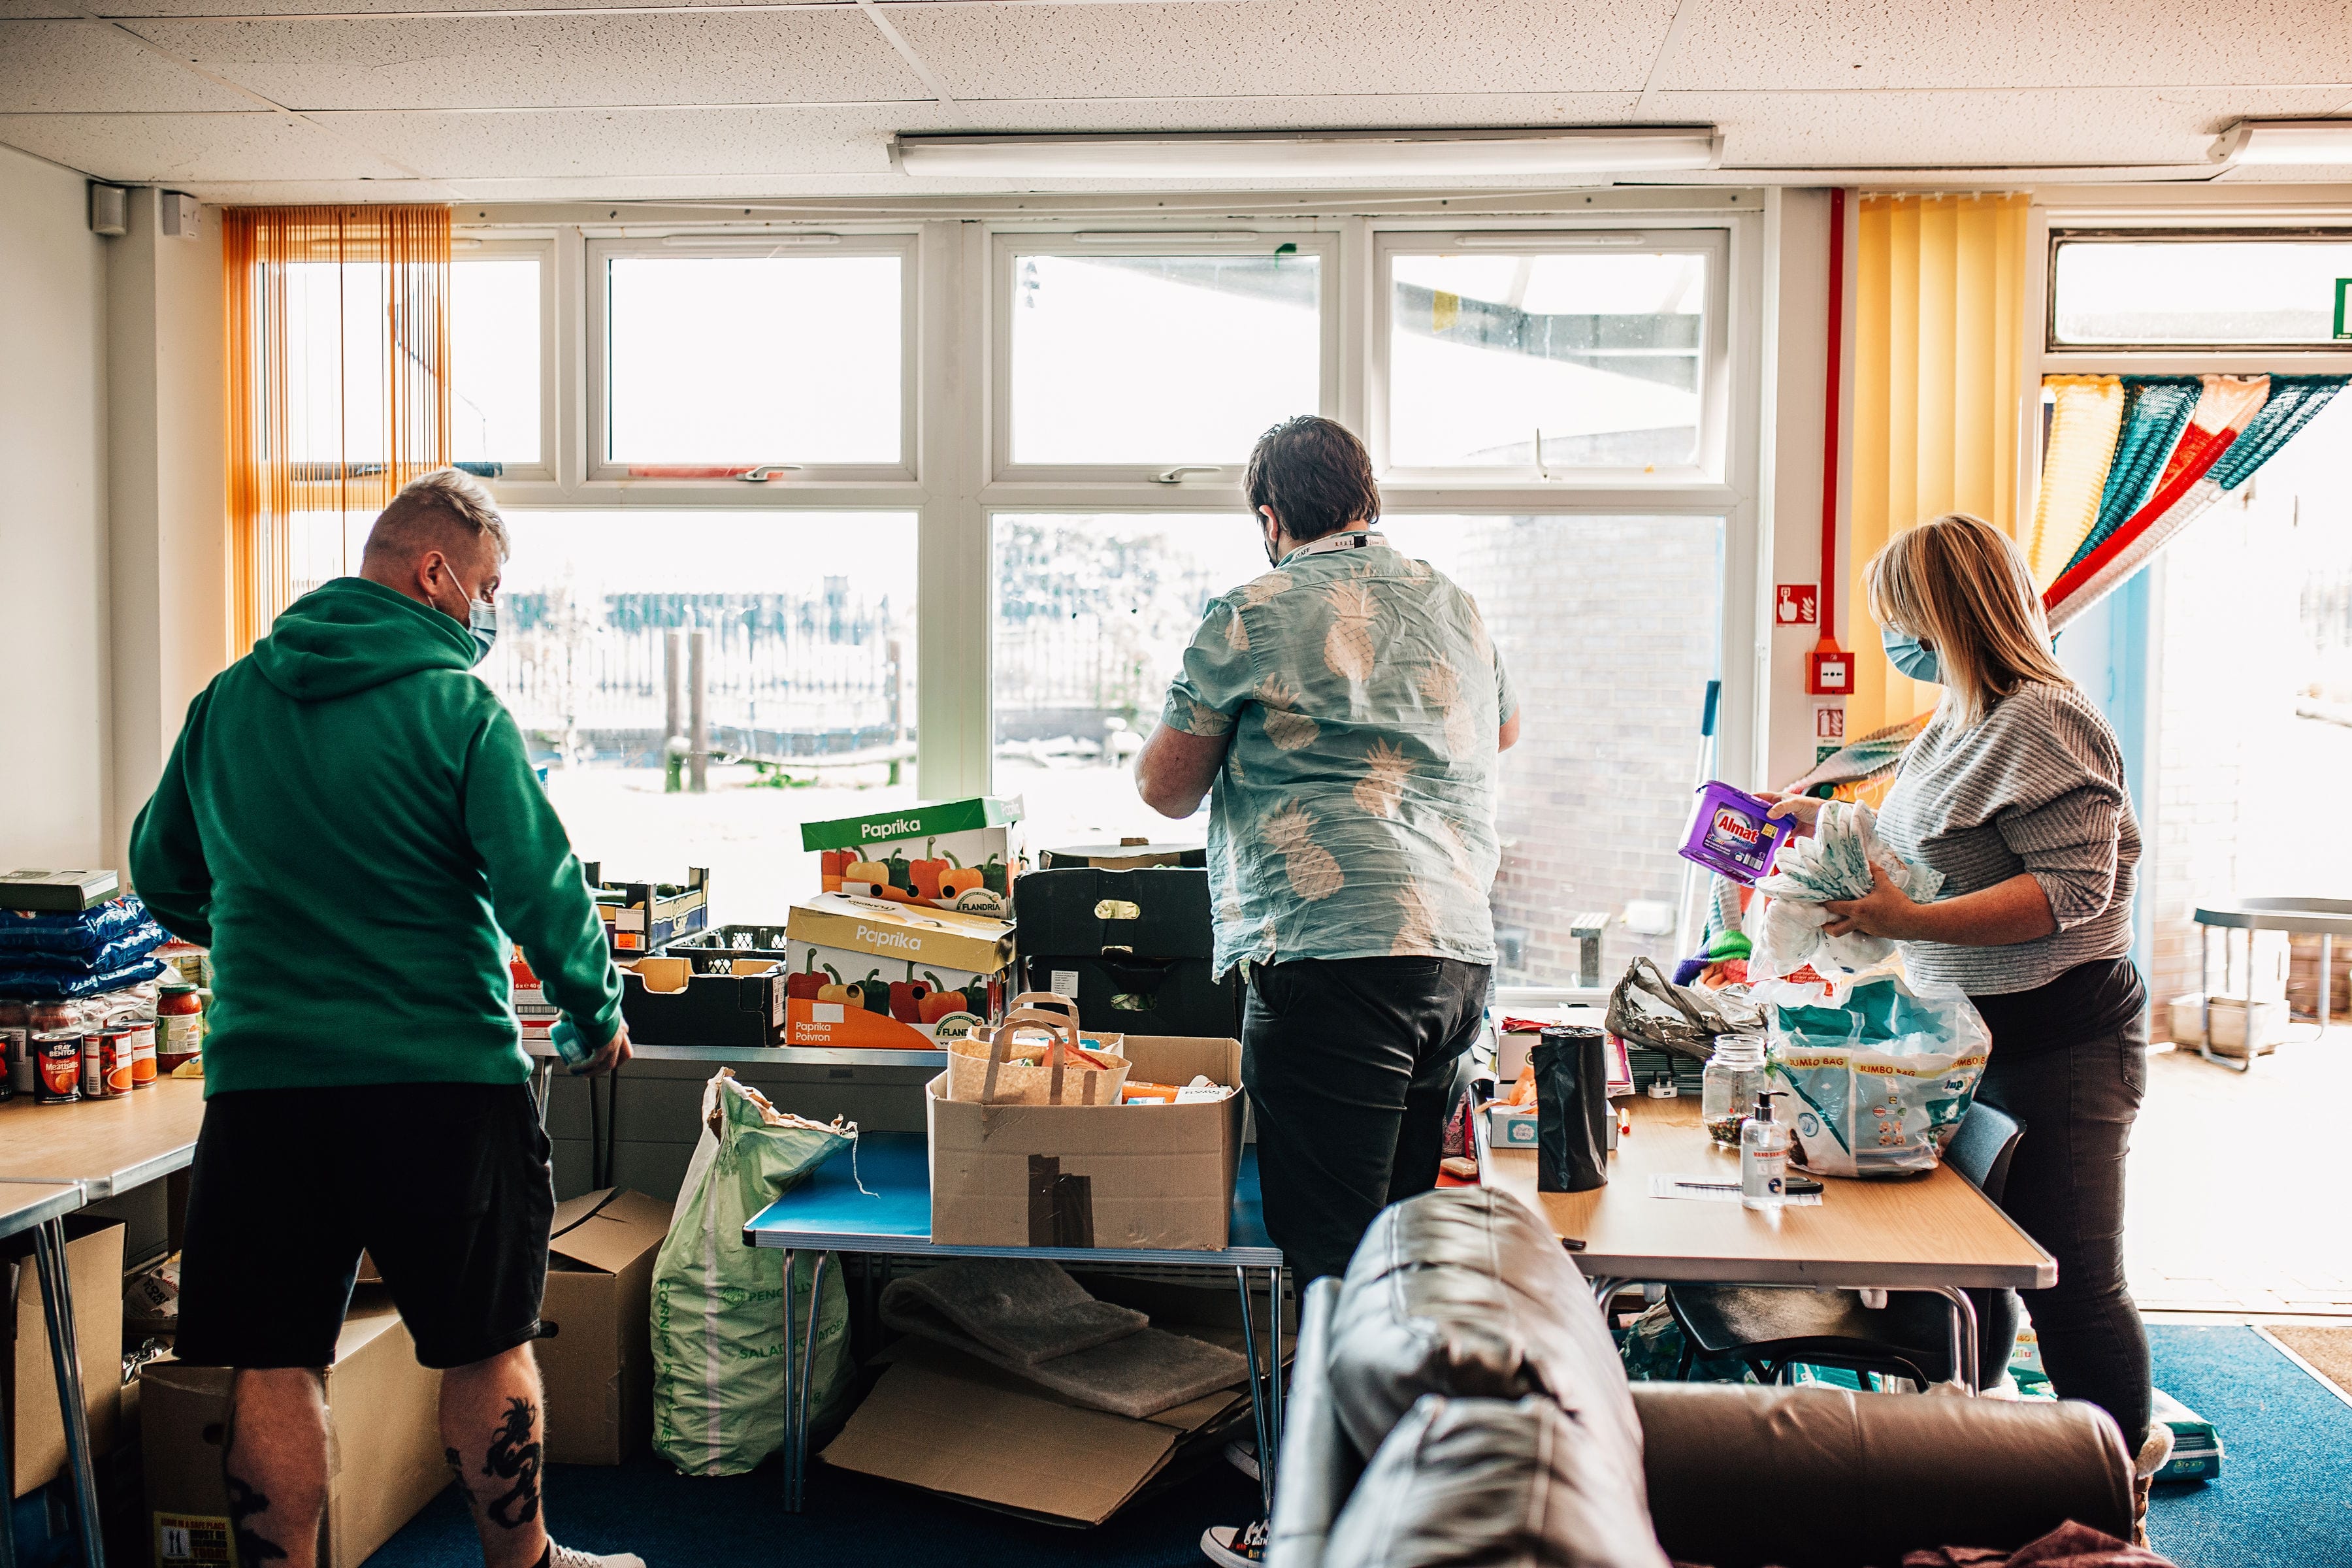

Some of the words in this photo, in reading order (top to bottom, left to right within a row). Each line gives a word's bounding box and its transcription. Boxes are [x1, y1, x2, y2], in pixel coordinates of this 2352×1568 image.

[861, 819, 921, 839] Paprika
[1718, 815, 1759, 843] Almat
[857, 925, 921, 951] Paprika
[796, 1022, 831, 1032] Paprika
[796, 1032, 830, 1041] Poivron
[46, 1061, 78, 1071] Meatballs
[1897, 1068, 1916, 1077] BAG
[749, 1282, 812, 1302] PENLL
[659, 1278, 673, 1358] CORNISH
[192, 1547, 227, 1560] TODAY
